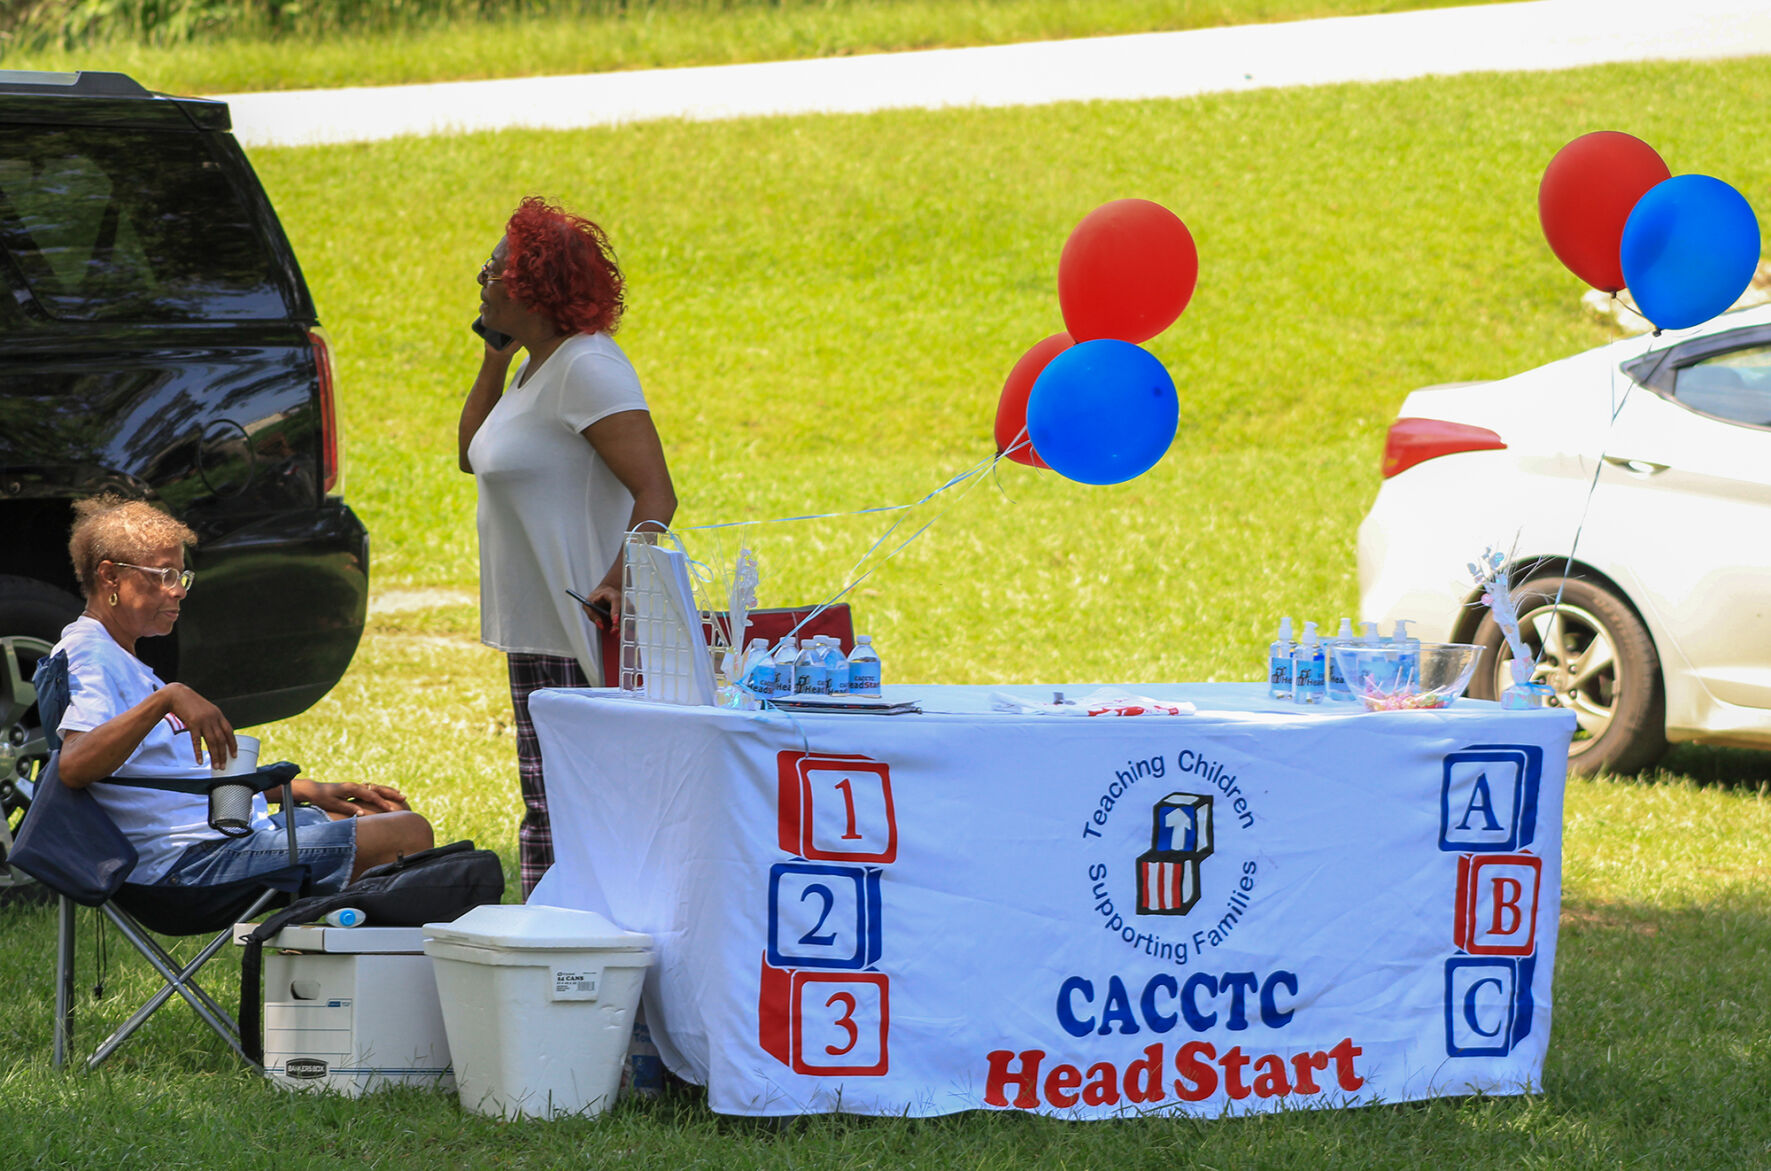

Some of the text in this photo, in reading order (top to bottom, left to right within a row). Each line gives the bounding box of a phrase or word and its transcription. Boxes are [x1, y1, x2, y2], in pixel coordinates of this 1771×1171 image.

[834, 778, 862, 840] 1
[1083, 750, 1255, 840] Teaching Children
[1455, 772, 1504, 831] A
[797, 883, 838, 946] 2
[1088, 860, 1257, 965] Supporting Families
[1486, 877, 1522, 936] B
[824, 991, 858, 1056] 3
[1056, 970, 1299, 1038] CACCTC
[1463, 977, 1503, 1038] C
